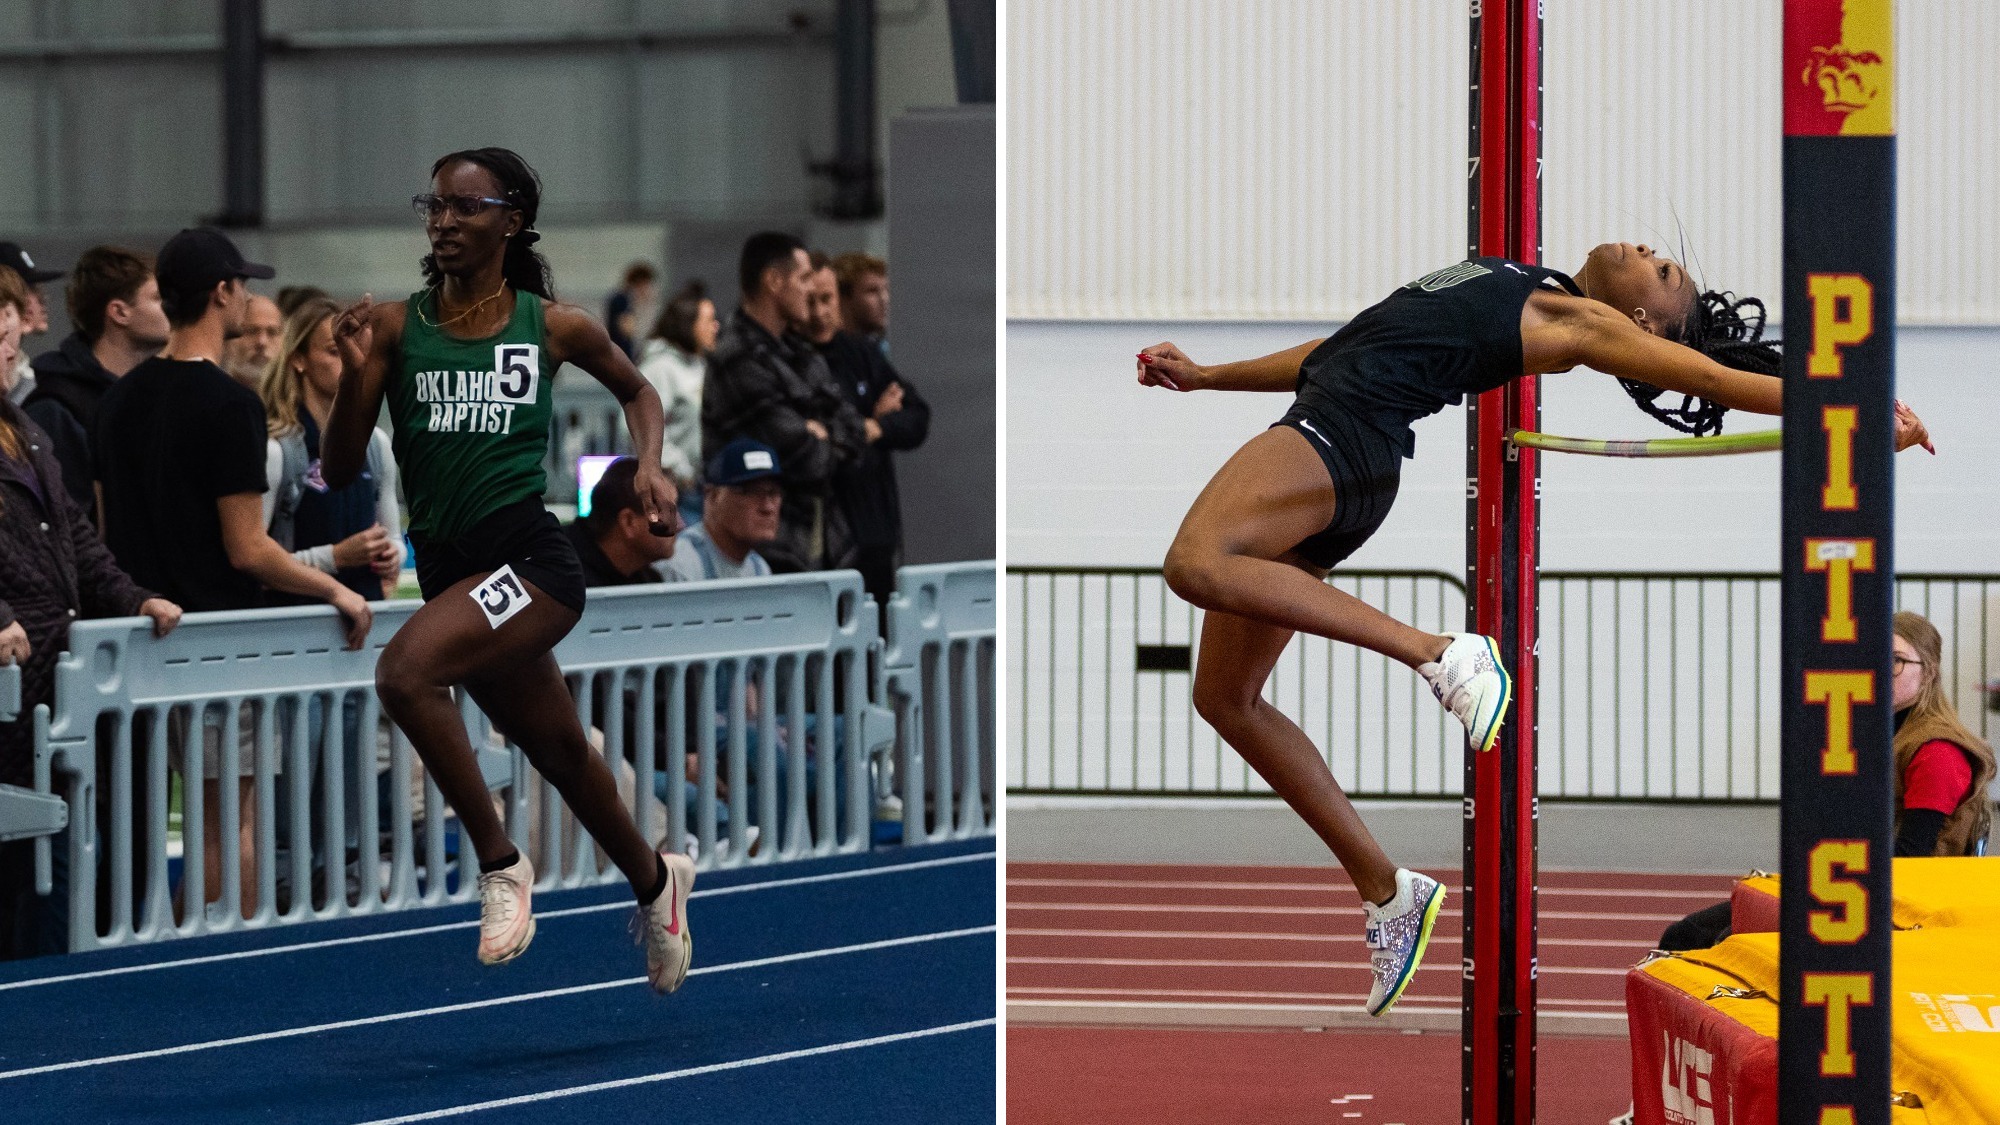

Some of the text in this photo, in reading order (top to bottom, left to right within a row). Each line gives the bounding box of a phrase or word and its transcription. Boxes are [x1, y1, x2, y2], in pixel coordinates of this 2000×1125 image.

[1470, 0, 1482, 18] 8
[1468, 157, 1481, 179] 7
[1536, 158, 1543, 179] 7
[500, 348, 531, 398] 5
[415, 370, 497, 403] OKLAHO
[428, 402, 515, 434] BAPTIST
[1466, 478, 1479, 499] 5
[1803, 273, 1876, 775] PITT
[480, 572, 523, 616] 5
[1463, 797, 1475, 819] 3
[1463, 957, 1475, 980] 2
[1530, 957, 1538, 980] 2
